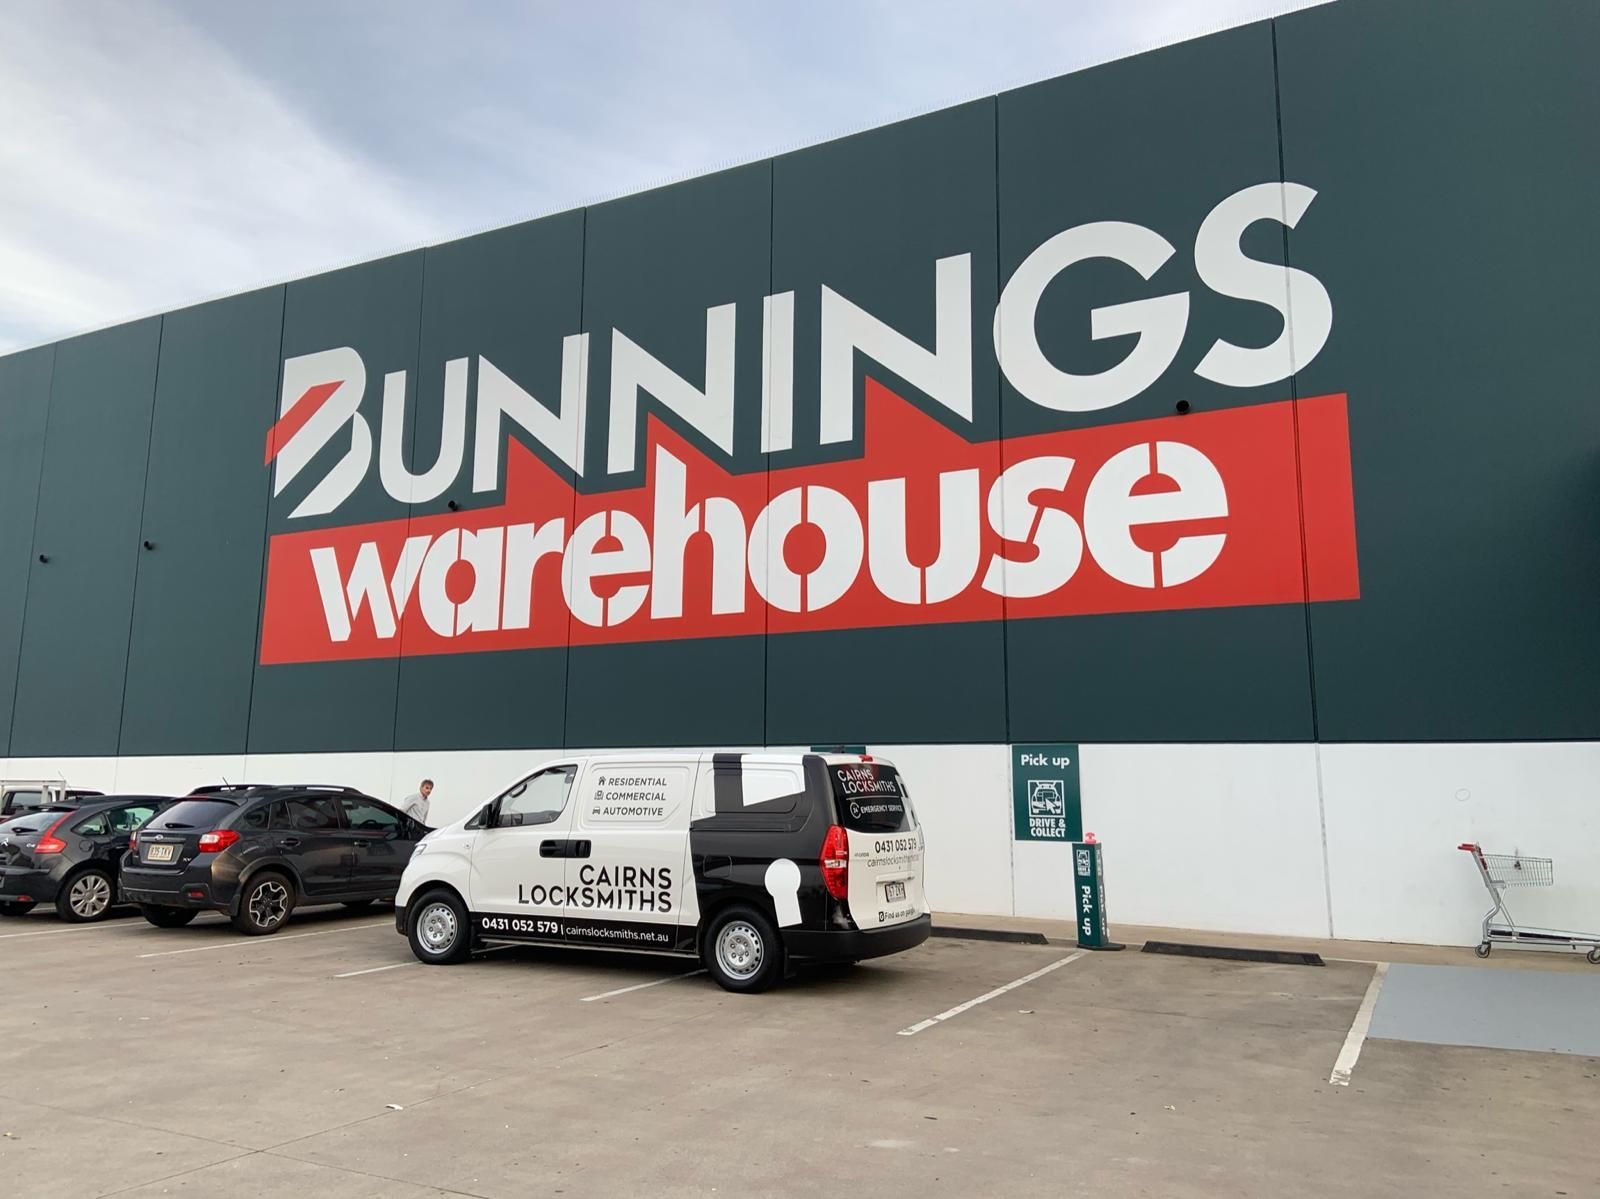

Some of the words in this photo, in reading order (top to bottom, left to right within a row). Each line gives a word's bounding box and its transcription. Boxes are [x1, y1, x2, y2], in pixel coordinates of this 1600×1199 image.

[266, 182, 1333, 518] BUNNINGS
[310, 440, 1229, 642] warehouse
[1020, 753, 1048, 766] Pick
[1052, 757, 1070, 770] up
[608, 777, 667, 786] RESIDENTIAL
[837, 768, 874, 782] CAIRNS
[842, 780, 896, 794] LOCKSMITHS
[606, 792, 666, 800] COMMERCIAL
[603, 806, 663, 816] AUTOMOTIVE
[860, 805, 888, 814] EMERGENCY
[1030, 818, 1056, 828] DRIVE
[1058, 818, 1066, 828] &
[1030, 828, 1066, 838] COLLECT
[875, 840, 894, 854] 0431
[895, 838, 907, 851] 052
[579, 864, 672, 890] CAIRNS
[518, 884, 672, 912] LOCKSMITHS
[1082, 886, 1092, 913] Pick
[482, 918, 508, 930] 0431
[512, 919, 534, 932] 052
[537, 921, 558, 934] 579
[566, 926, 668, 942] cairnslocksmiths.net.au
[1084, 918, 1092, 936] up
